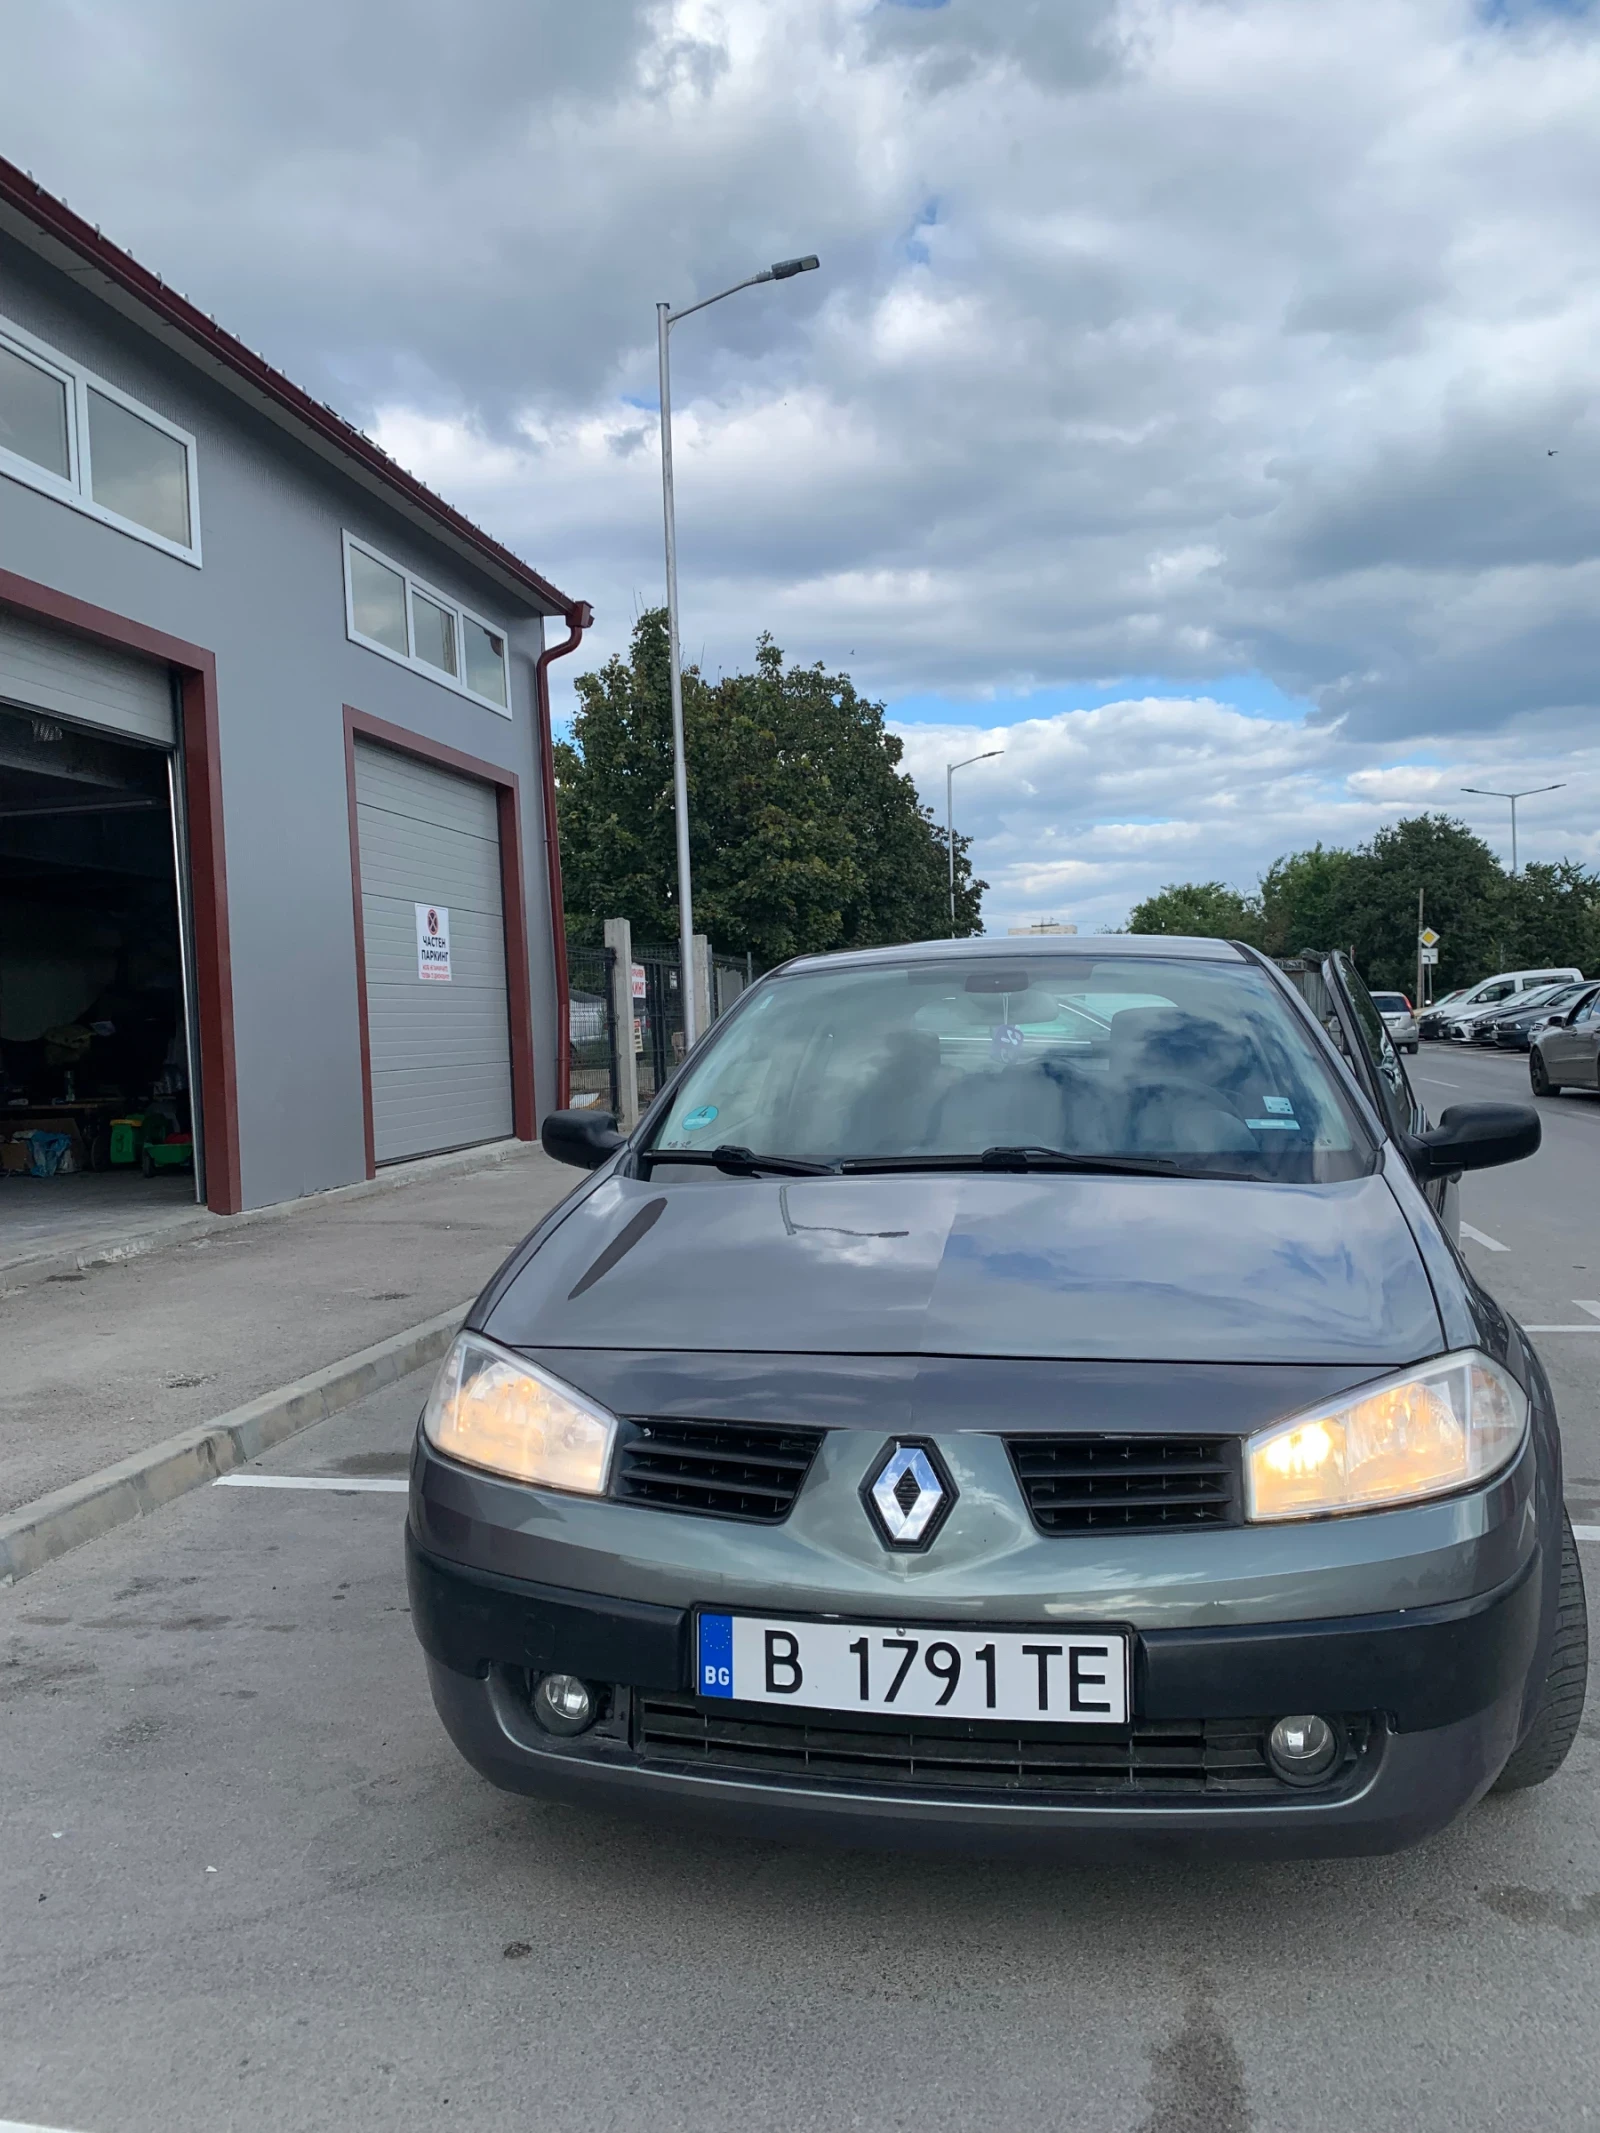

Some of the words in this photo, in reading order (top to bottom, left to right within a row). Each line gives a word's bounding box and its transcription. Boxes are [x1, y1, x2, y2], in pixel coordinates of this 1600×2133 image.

[422, 936, 446, 948] ЧАСТЕН
[421, 949, 449, 962] ПАРКИНГ
[705, 1665, 730, 1686] BG
[764, 1629, 803, 1694] B
[849, 1636, 997, 1709] 1791
[1021, 1644, 1111, 1713] TE
